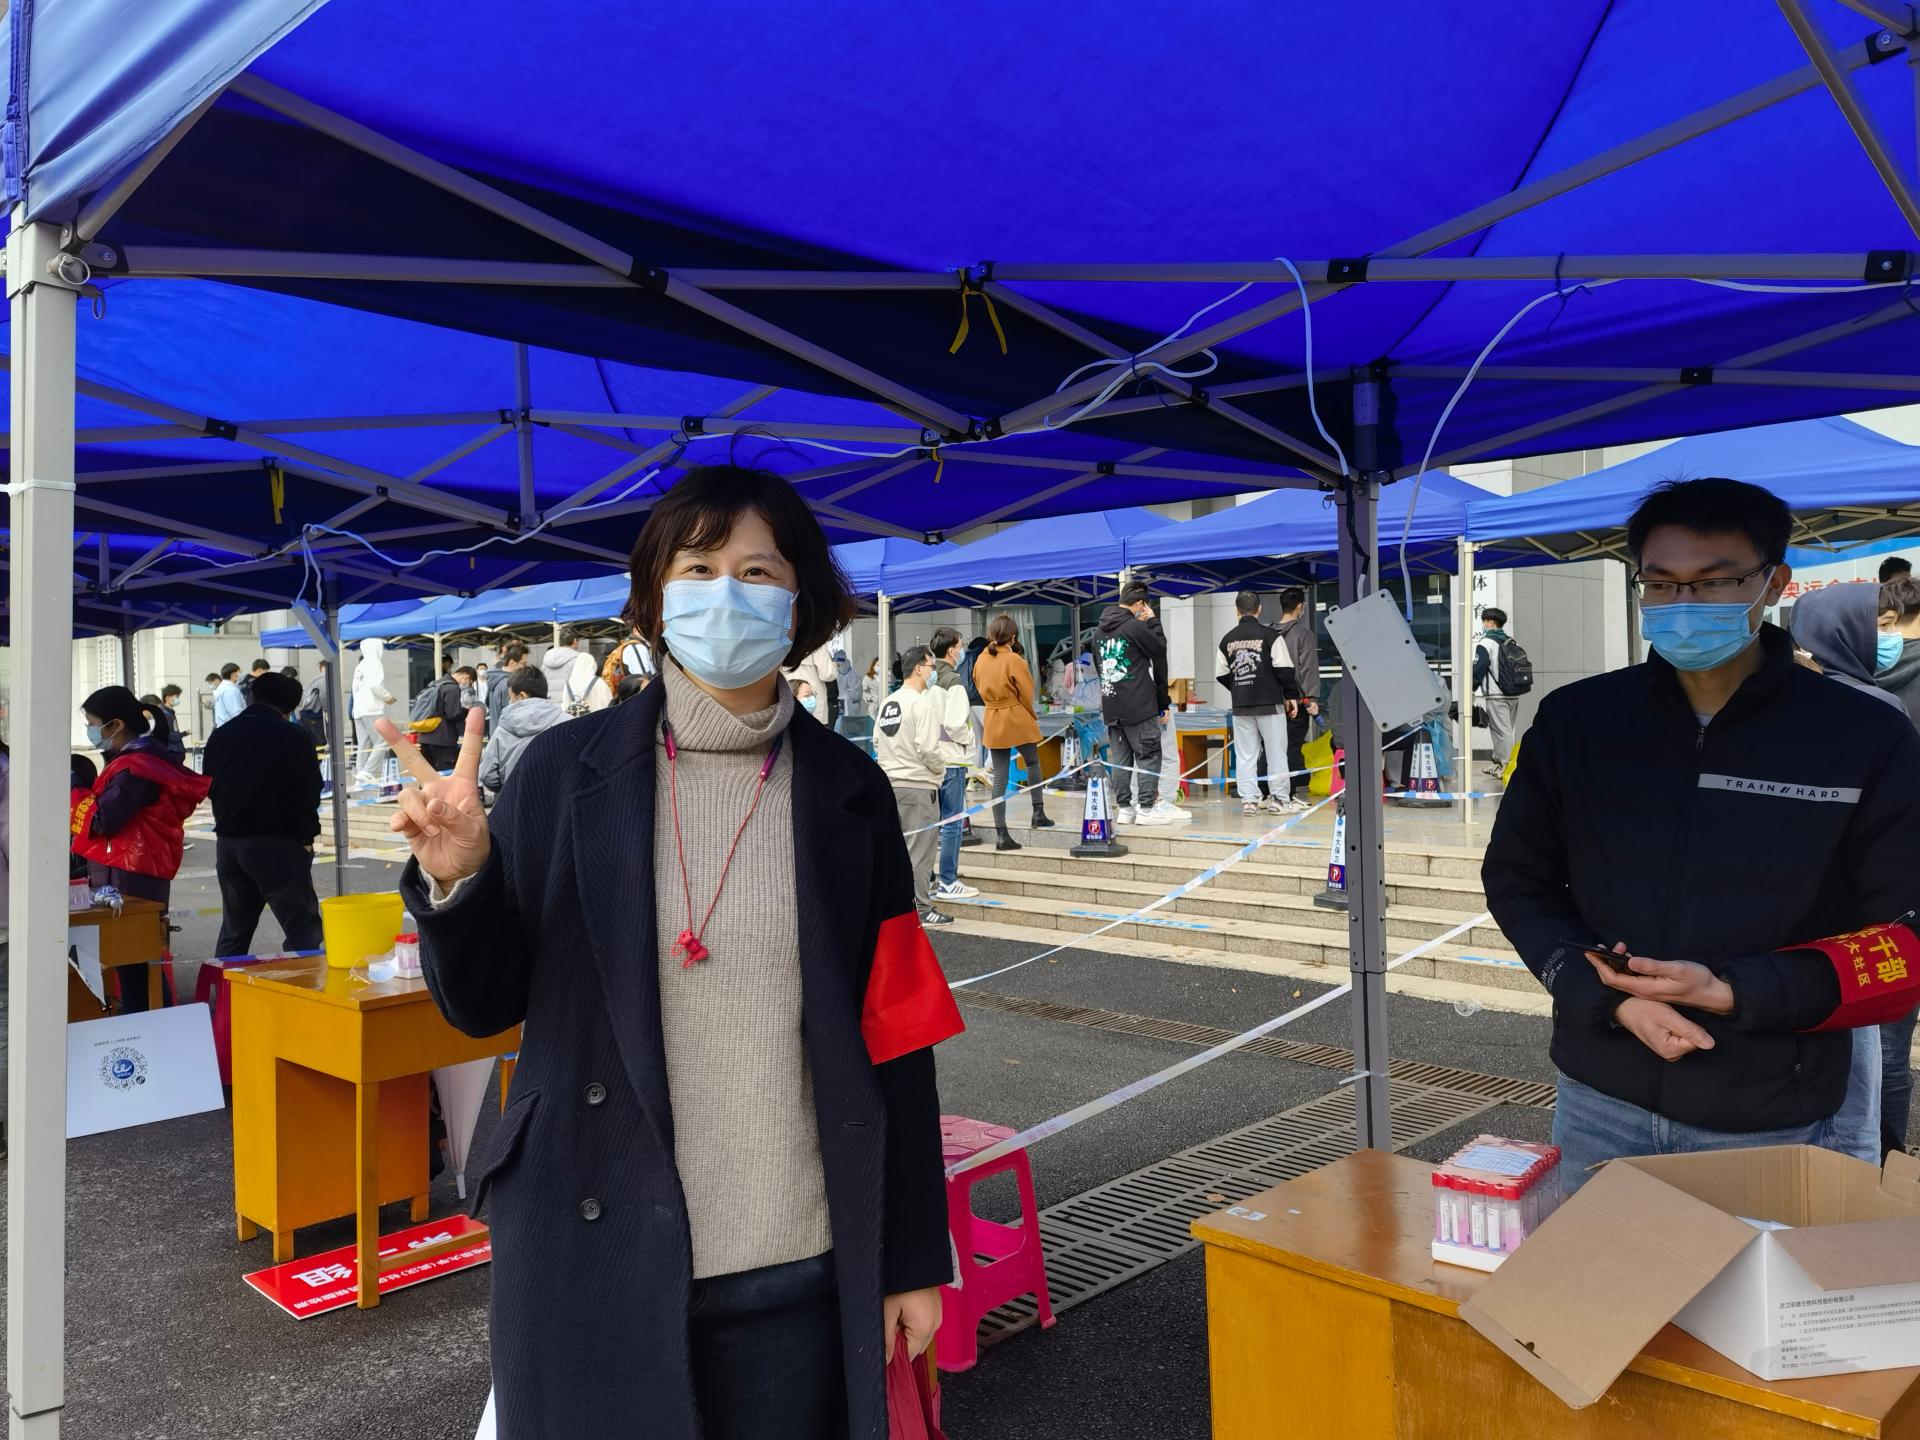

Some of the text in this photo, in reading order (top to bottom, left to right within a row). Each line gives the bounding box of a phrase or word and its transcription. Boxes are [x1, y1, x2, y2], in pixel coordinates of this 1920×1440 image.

[1725, 779, 1776, 792] TRAIN
[1796, 788, 1840, 799] HARD
[1091, 791, 1099, 819] 地大保卫
[1334, 830, 1343, 863] 地大保卫
